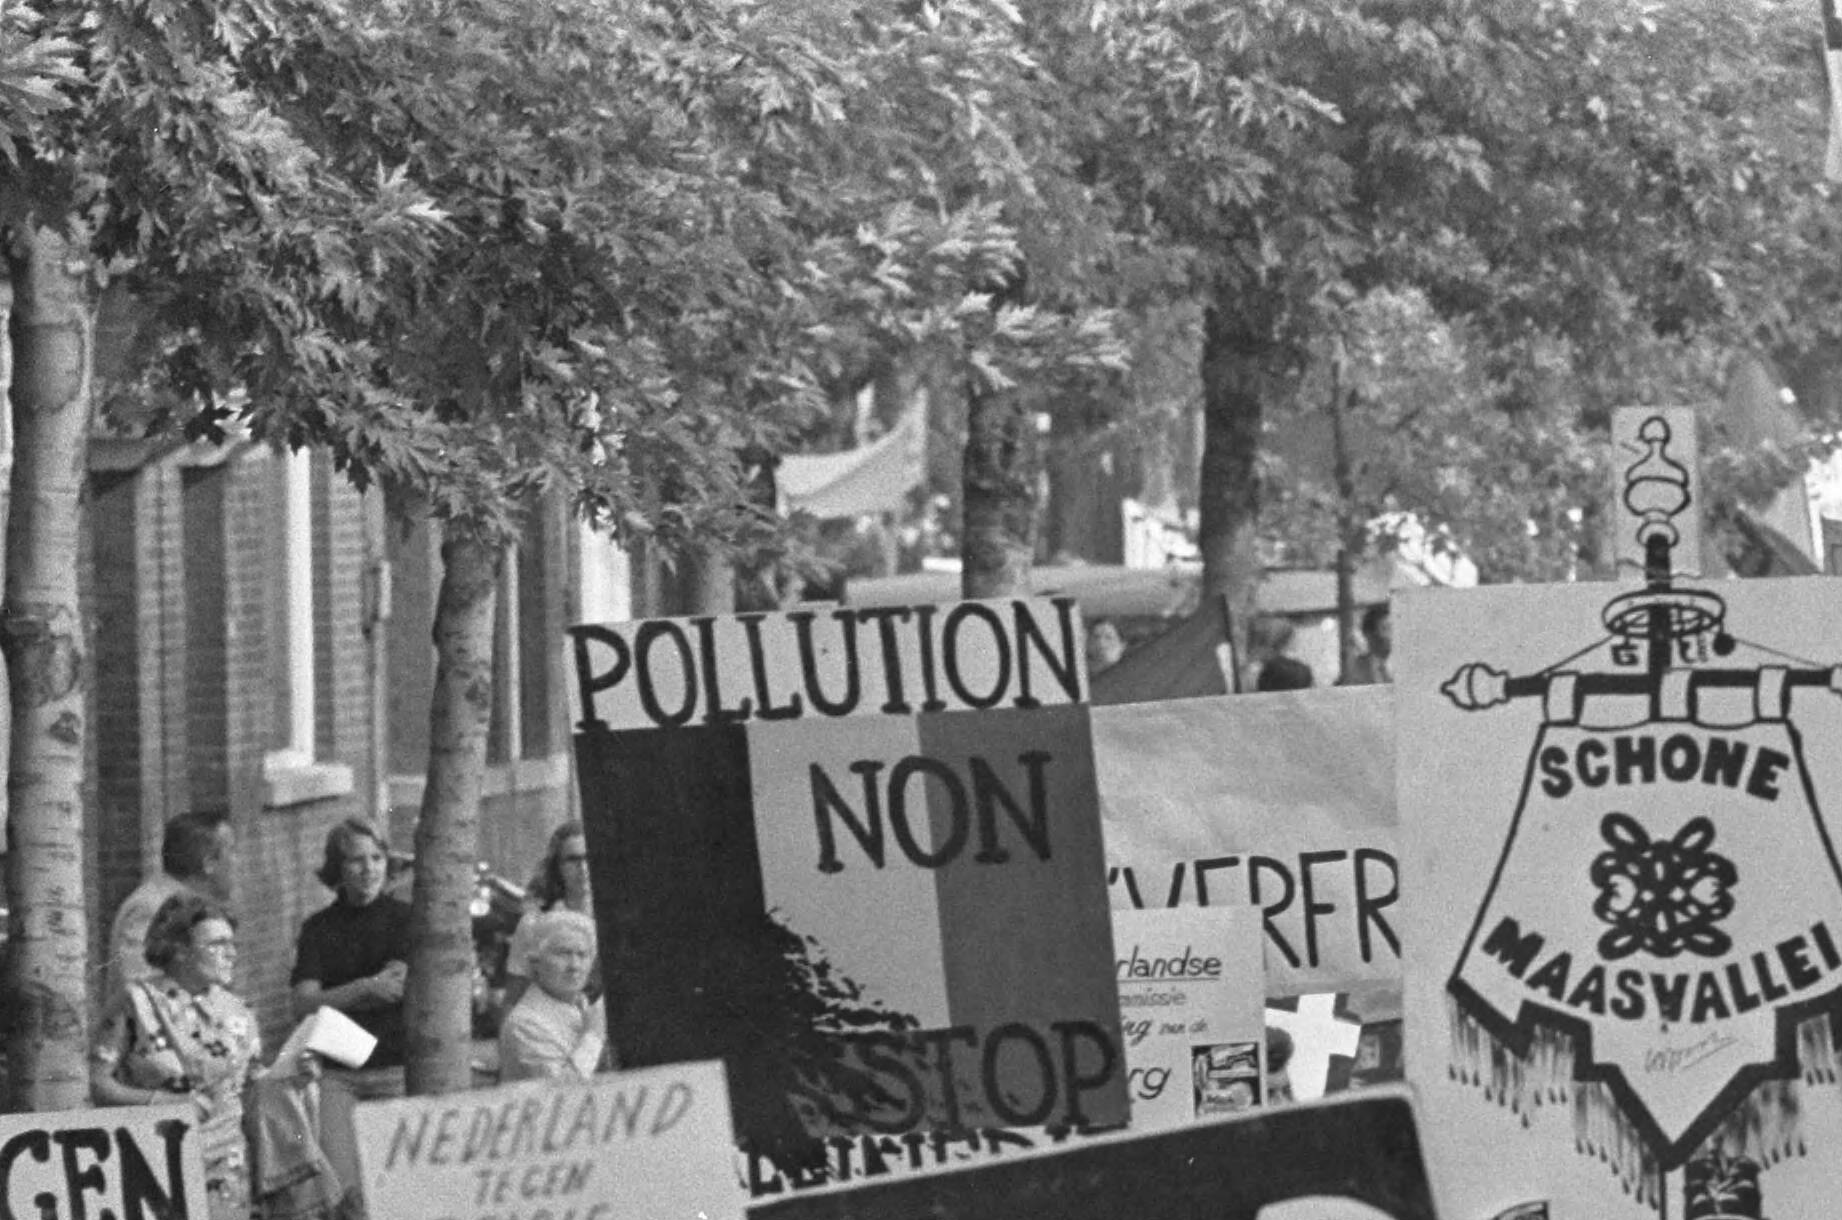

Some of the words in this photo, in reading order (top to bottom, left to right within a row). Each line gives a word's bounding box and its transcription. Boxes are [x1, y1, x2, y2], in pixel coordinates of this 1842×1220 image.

[565, 599, 1083, 733] POLLUTION
[1540, 734, 1790, 801] SCHONE
[809, 751, 1054, 874] NON
[385, 1081, 696, 1170] NEDERLAND
[473, 1158, 595, 1201] TEGEN
